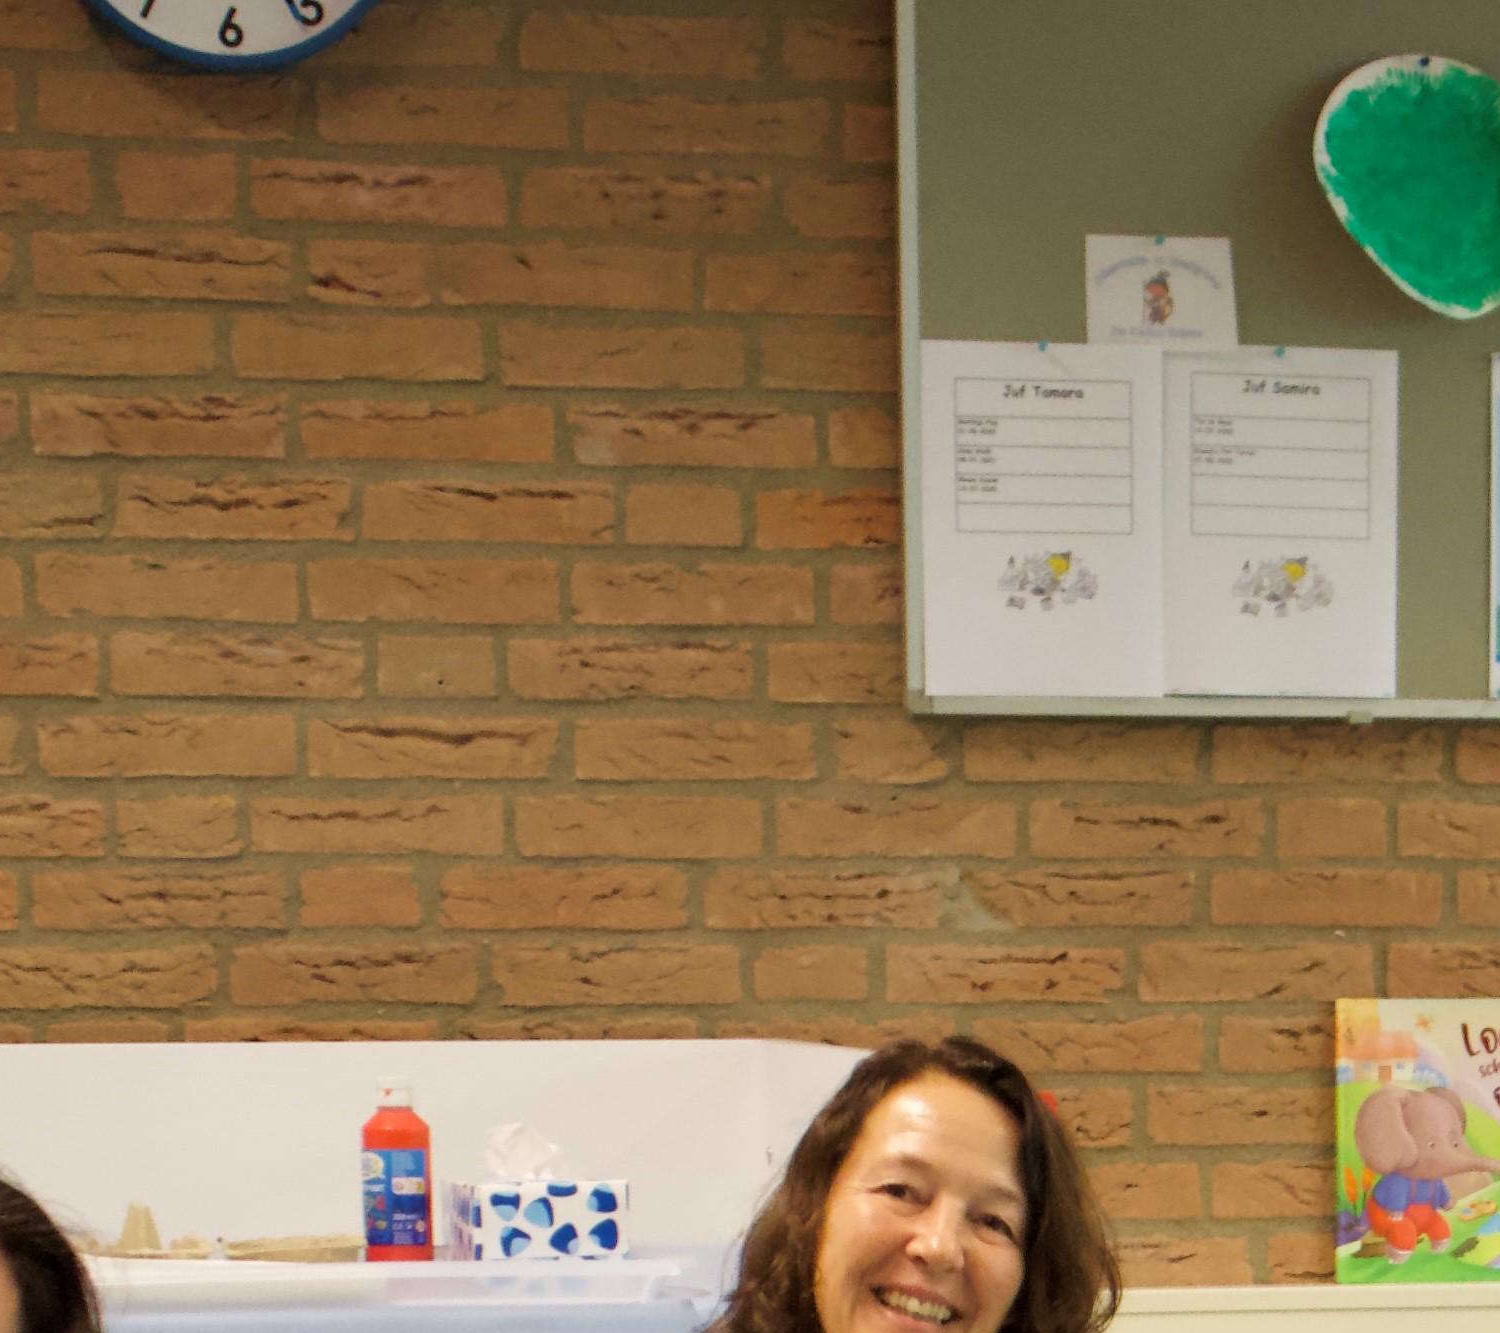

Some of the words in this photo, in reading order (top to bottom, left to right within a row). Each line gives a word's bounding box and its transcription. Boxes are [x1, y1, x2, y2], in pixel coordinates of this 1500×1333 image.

[218, 5, 244, 48] 6
[1002, 384, 1026, 399] Juf
[1032, 385, 1085, 400] Tamara
[1242, 379, 1266, 394] Juf
[1272, 381, 1321, 396] Samira
